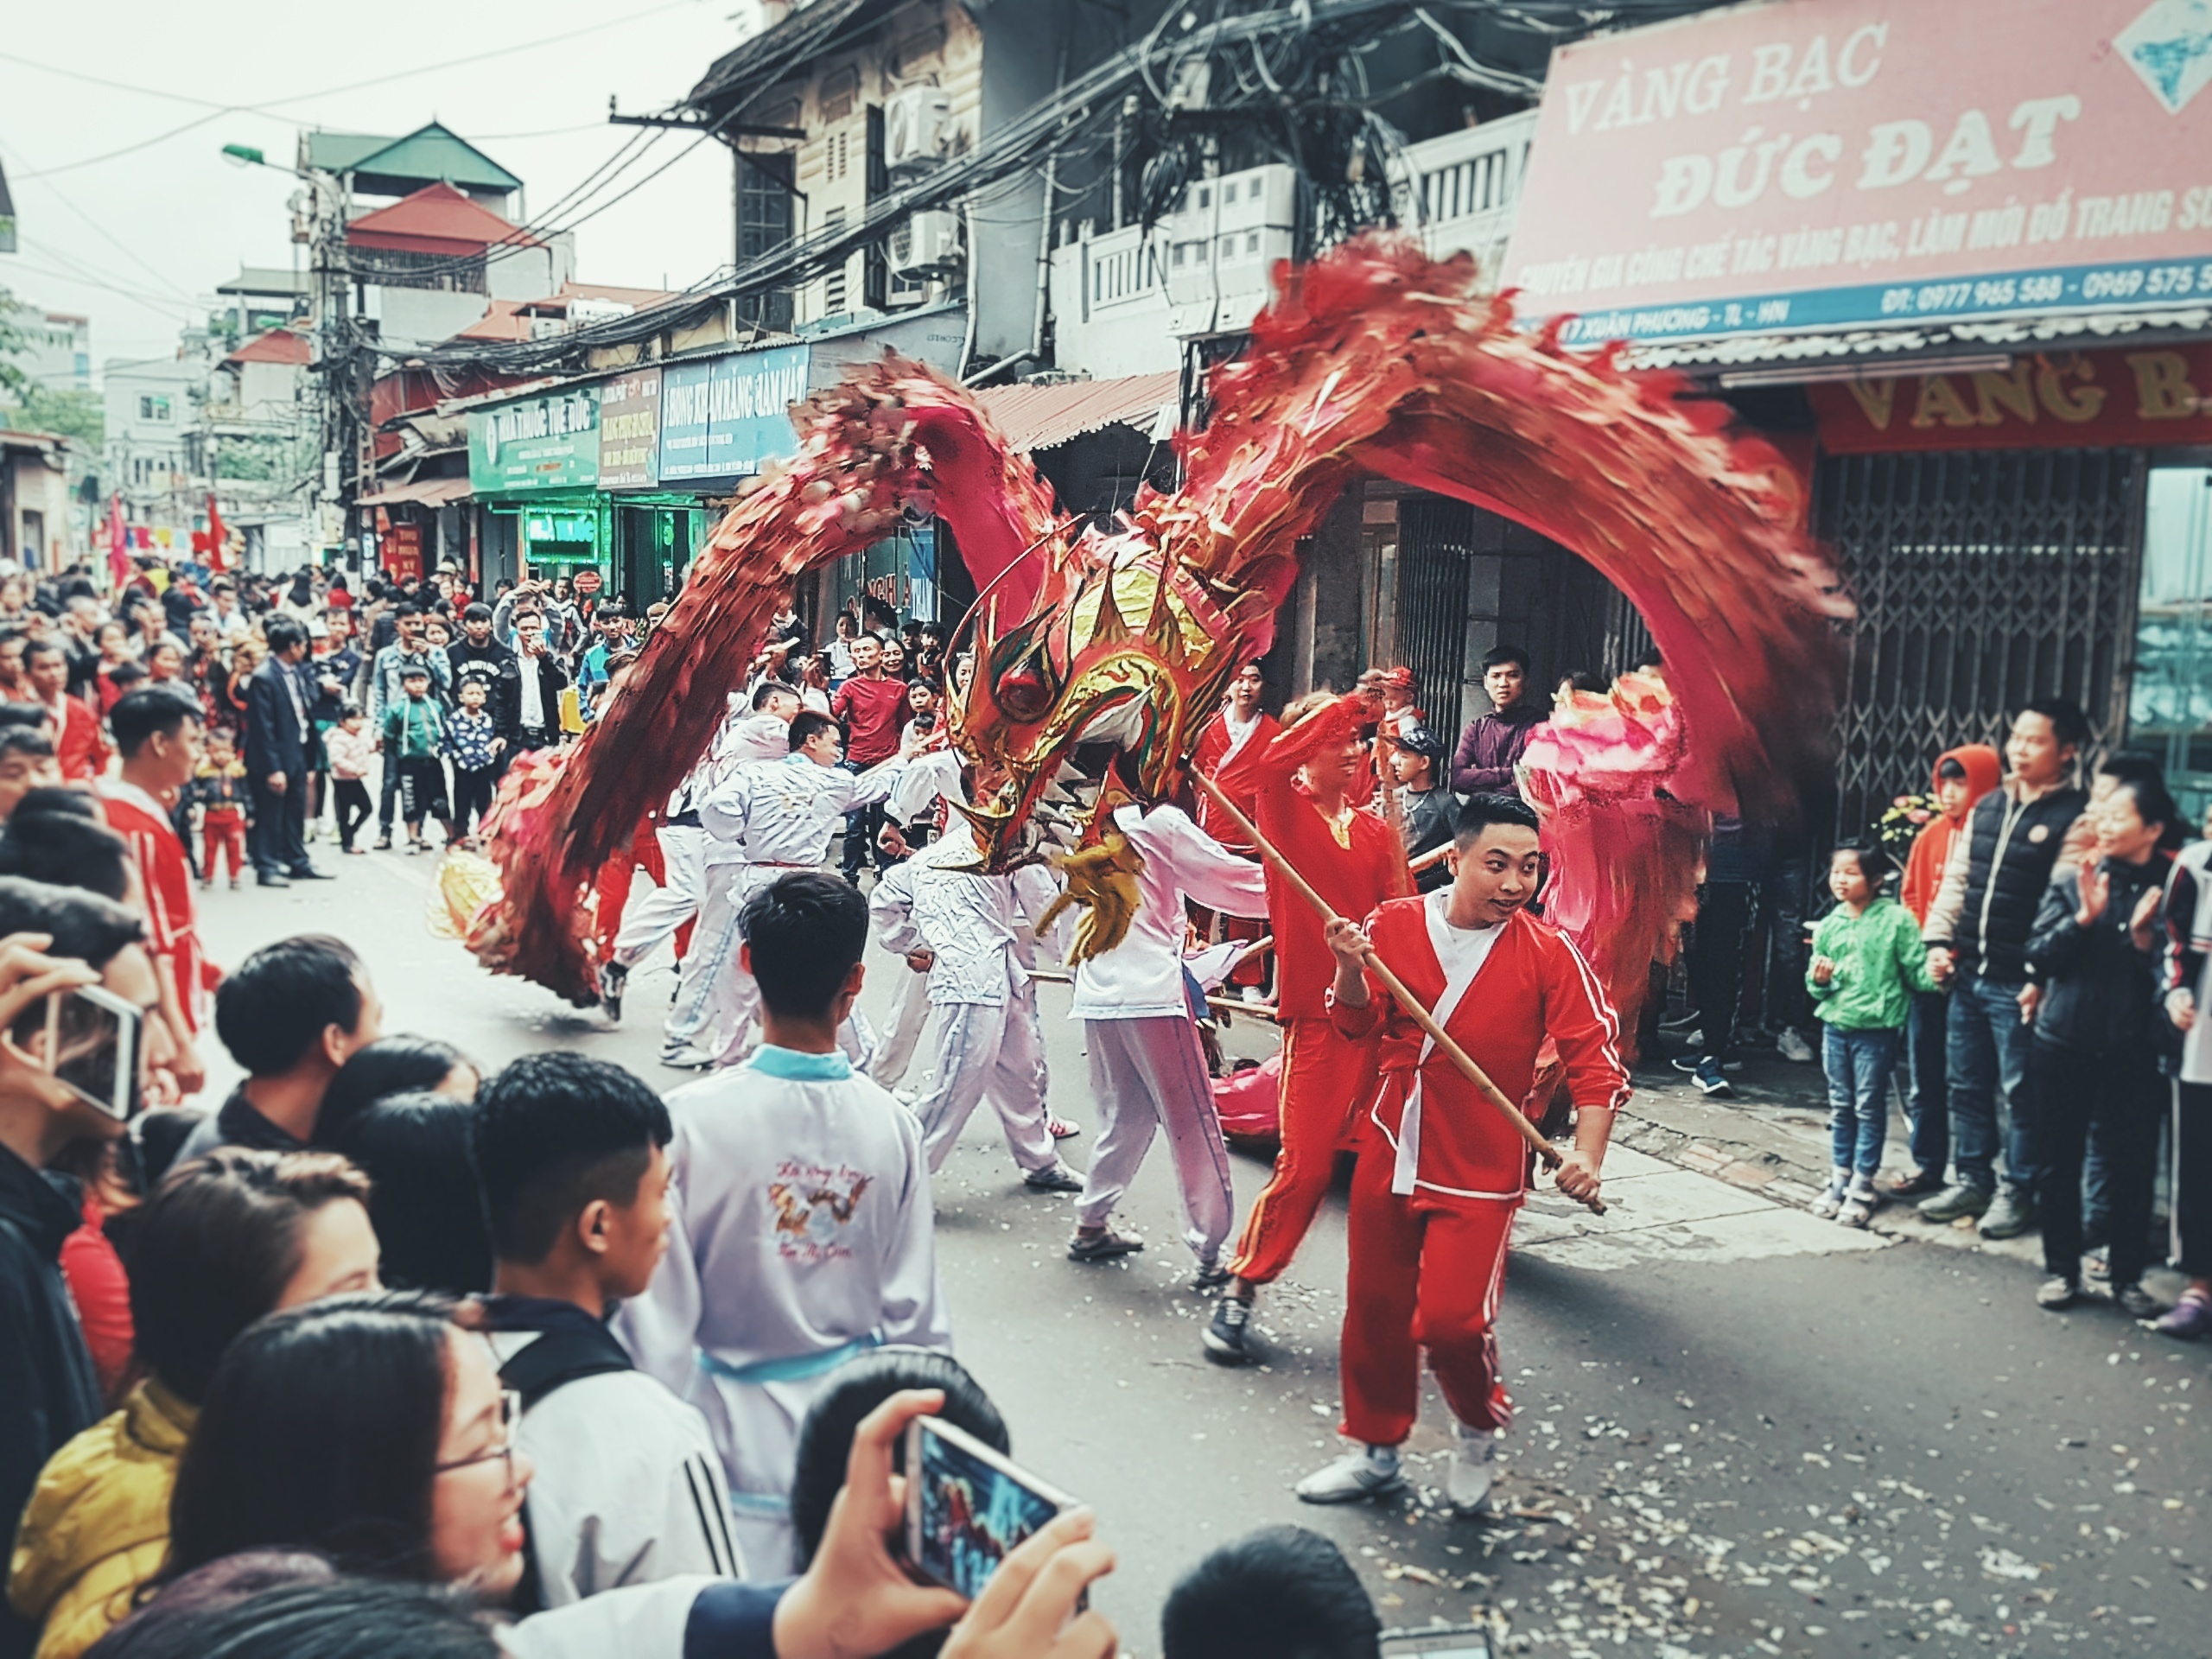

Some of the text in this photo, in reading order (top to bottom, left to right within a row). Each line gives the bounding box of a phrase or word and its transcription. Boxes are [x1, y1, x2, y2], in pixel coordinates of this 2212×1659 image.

[1562, 22, 1890, 135] VÀNG BẠC
[1647, 93, 2082, 219] ĐỨC ĐẠT
[1588, 253, 1626, 290] GIA
[1624, 244, 1686, 285] CÔNG
[1729, 229, 1777, 276] TÁC
[1777, 222, 1845, 271] VÀNG
[1842, 219, 1901, 271] BẠC,
[1905, 207, 1969, 258] LÀM
[1966, 194, 2026, 252] MỚI
[2074, 188, 2175, 242] TRANG
[1580, 309, 1632, 342] XUÂN
[1915, 282, 1973, 312] 0977
[2144, 265, 2196, 296] 575
